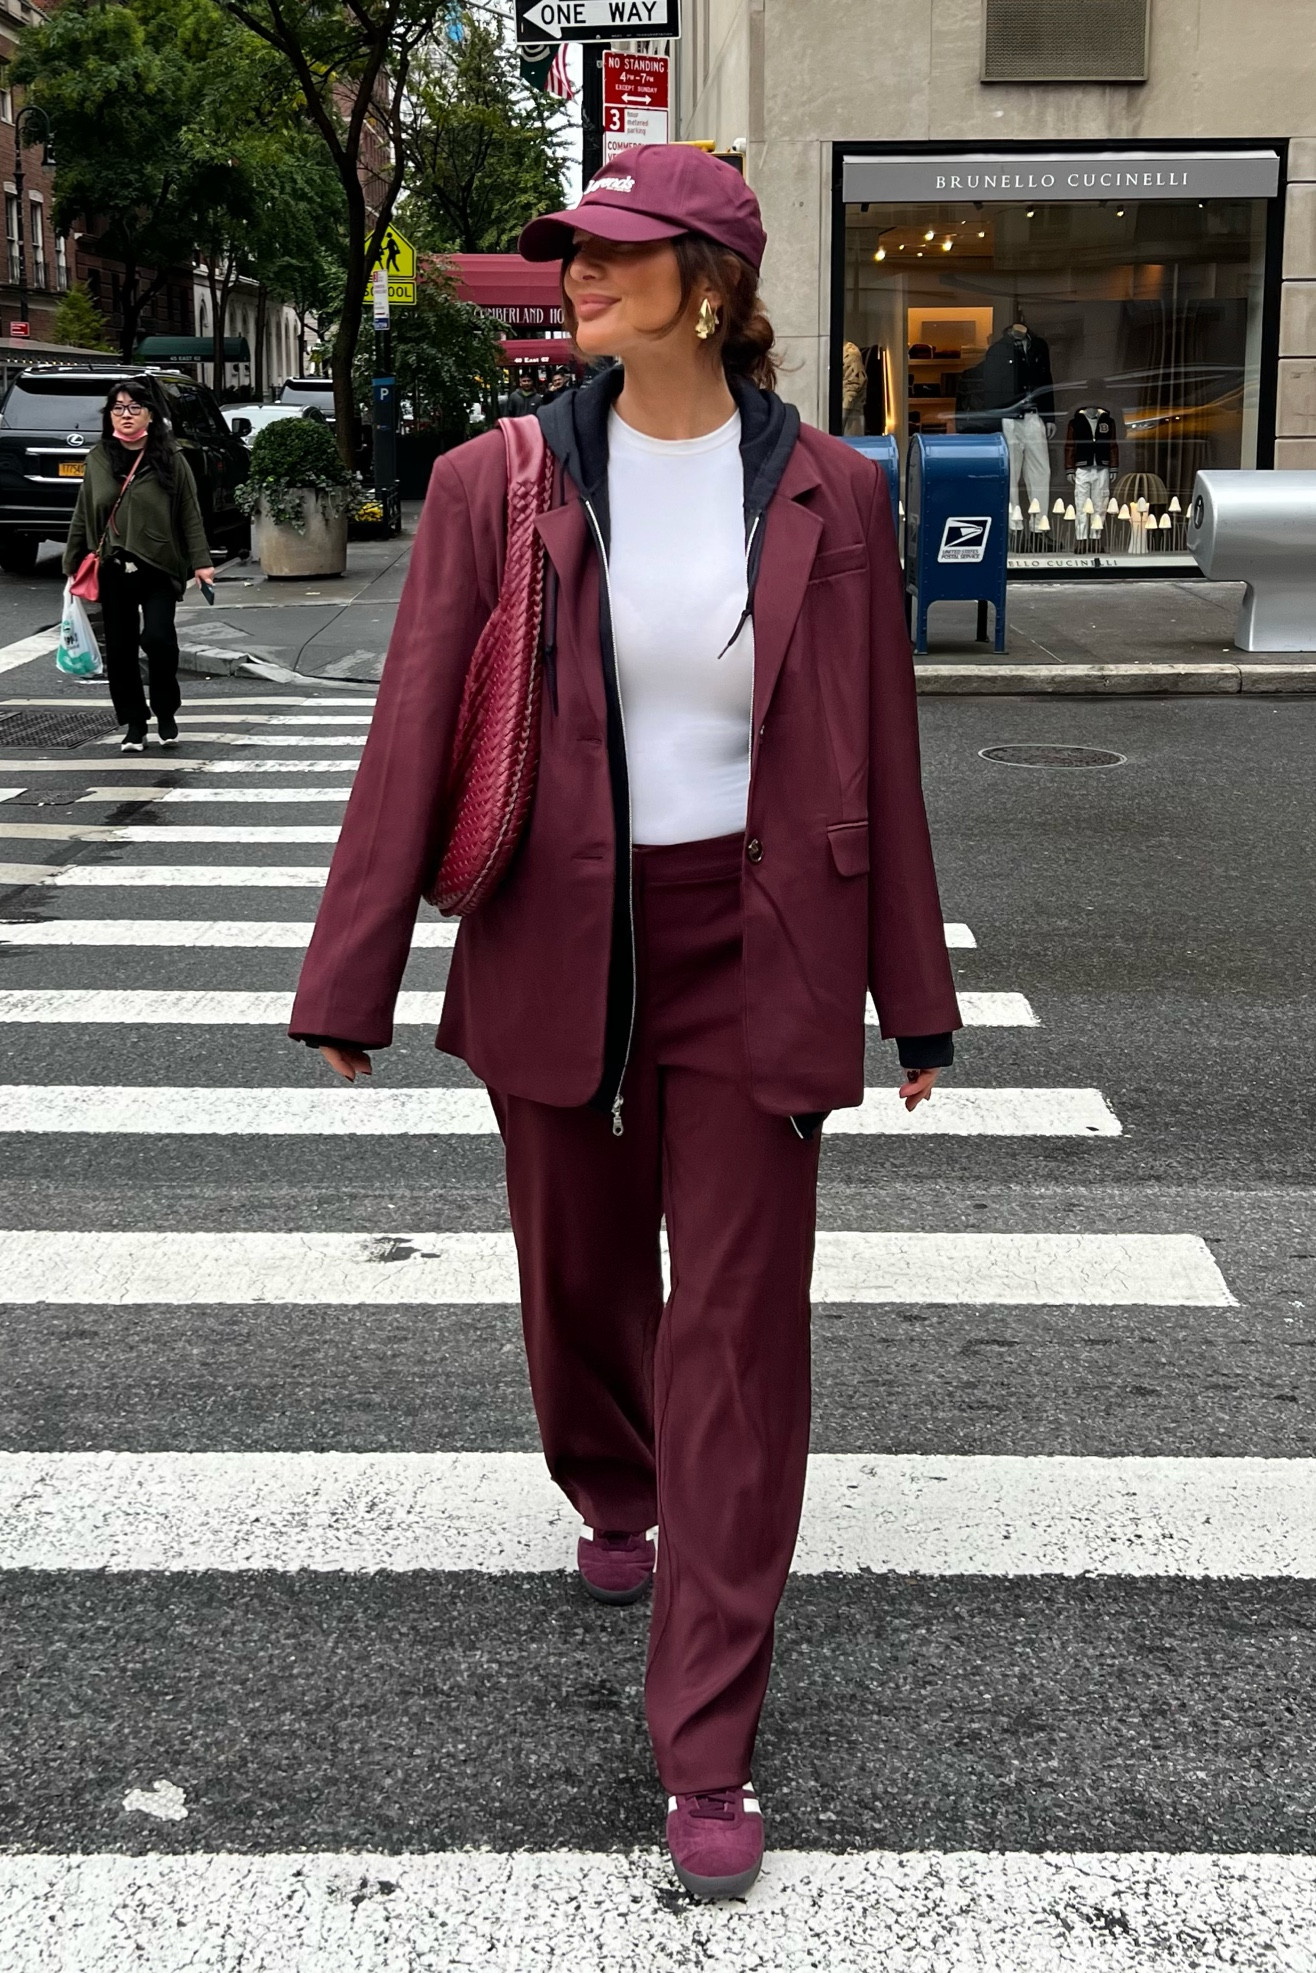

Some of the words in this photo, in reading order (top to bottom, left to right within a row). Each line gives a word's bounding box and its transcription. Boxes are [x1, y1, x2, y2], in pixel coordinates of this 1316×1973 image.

[541, 4, 586, 25] ONE
[609, 1, 657, 23] WAY
[608, 57, 620, 69] NO
[624, 58, 665, 73] STANDING
[615, 84, 635, 92] EXCEPT
[637, 86, 658, 94] SUNDAY
[609, 108, 620, 131] 3
[936, 174, 1055, 189] BRUNELLO
[1067, 172, 1188, 187] CUCINELLI
[364, 286, 412, 298] OOL
[380, 387, 390, 401] P
